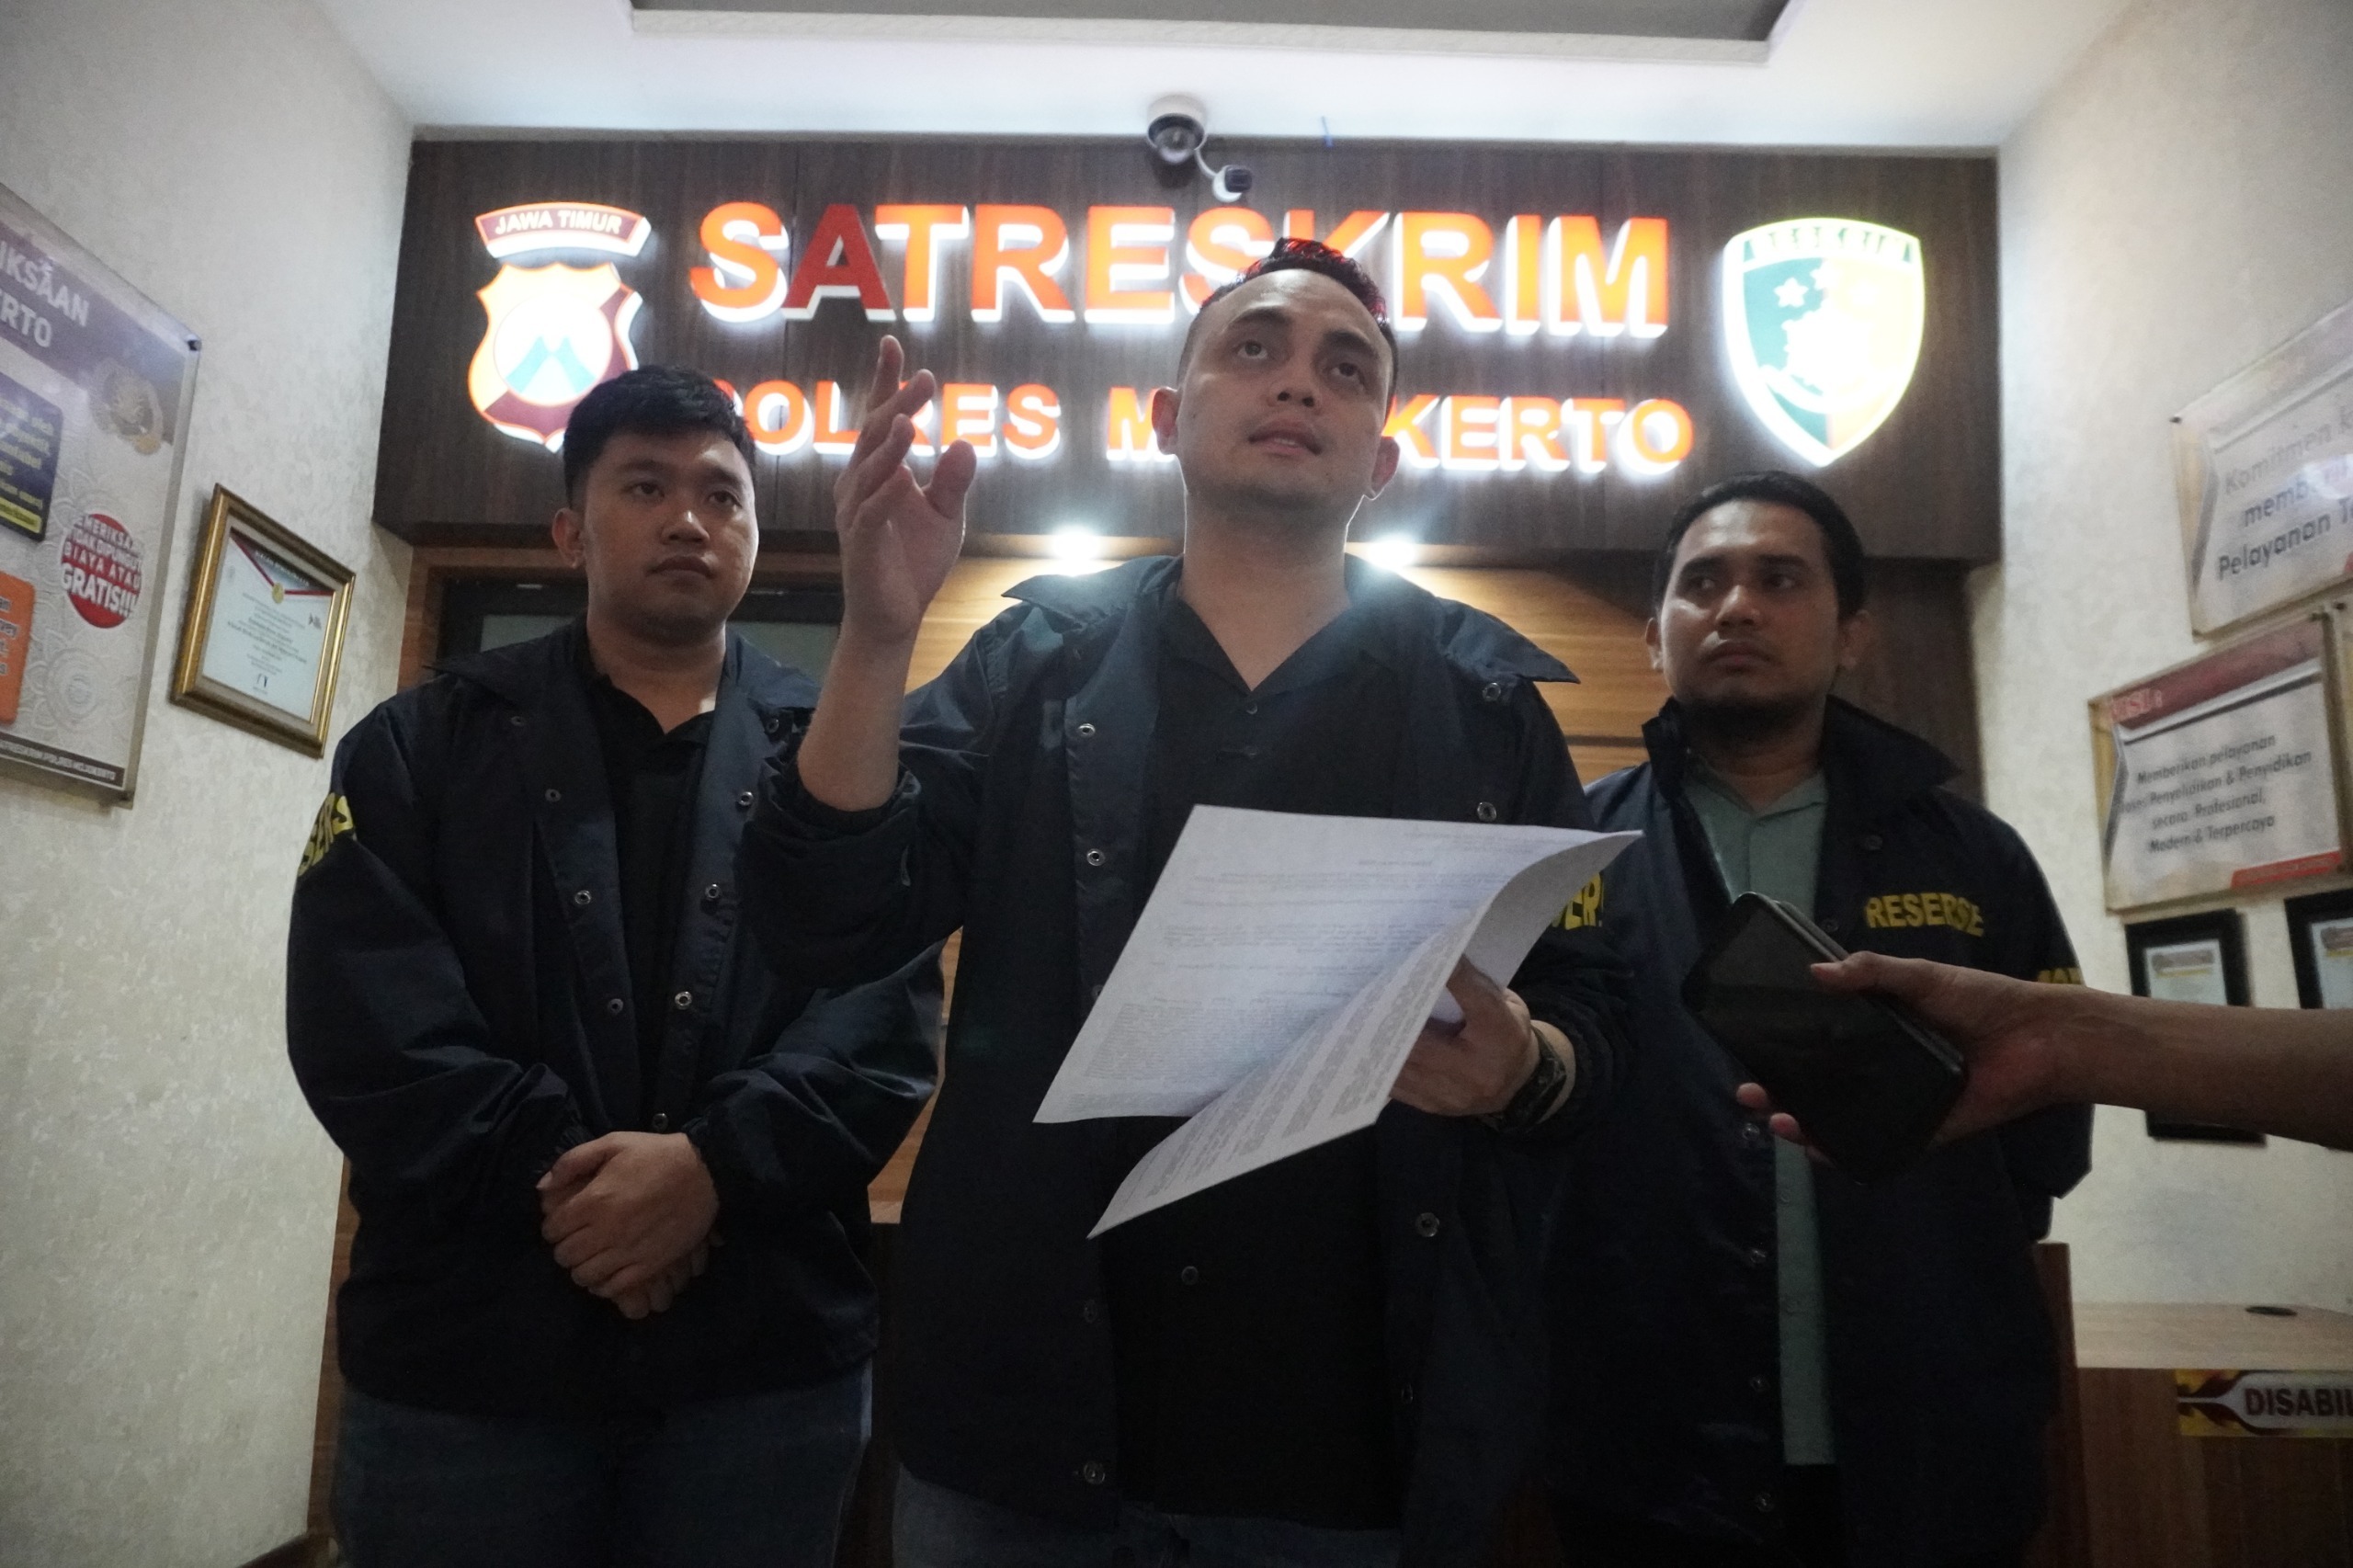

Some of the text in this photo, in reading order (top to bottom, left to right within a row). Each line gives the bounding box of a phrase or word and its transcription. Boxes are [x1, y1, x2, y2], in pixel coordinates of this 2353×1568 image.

[494, 209, 623, 235] JAWA TIMUR
[0, 288, 52, 348] RTO
[713, 379, 1694, 474] OLES MKERTO
[2217, 513, 2332, 581] Pelayanan
